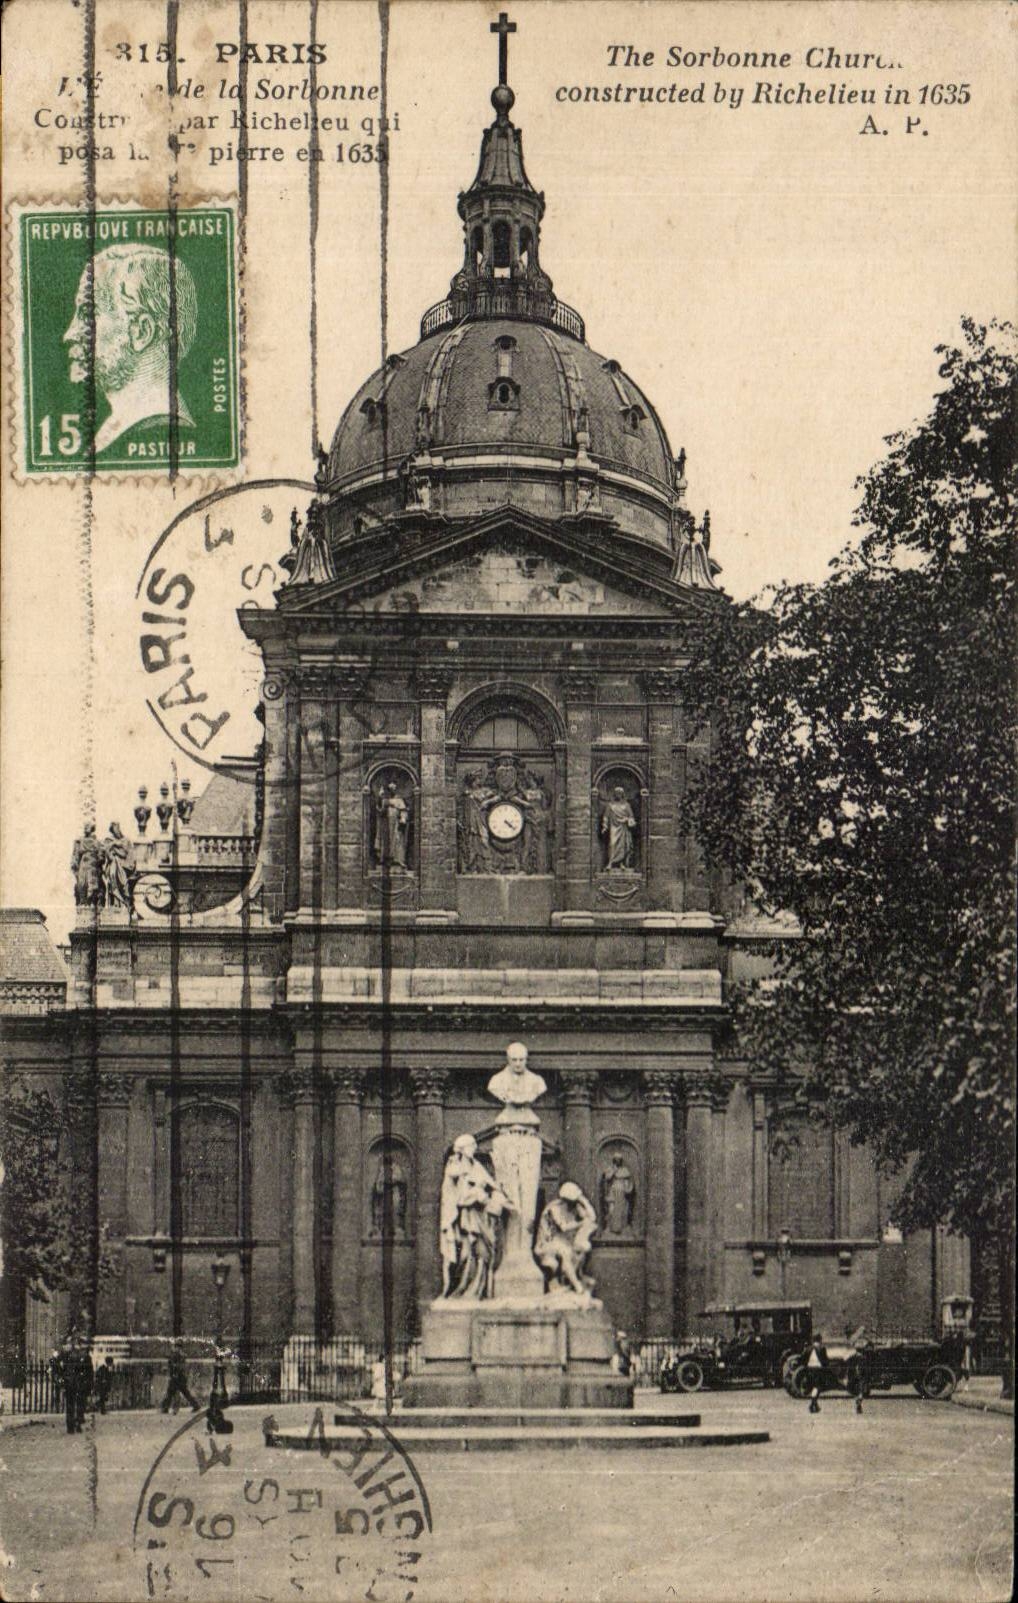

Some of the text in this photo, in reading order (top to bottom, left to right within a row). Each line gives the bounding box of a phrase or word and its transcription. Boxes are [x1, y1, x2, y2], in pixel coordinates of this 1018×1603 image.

[213, 357, 226, 413] POSTES
[38, 413, 82, 456] 15
[140, 567, 231, 750] PARIS
